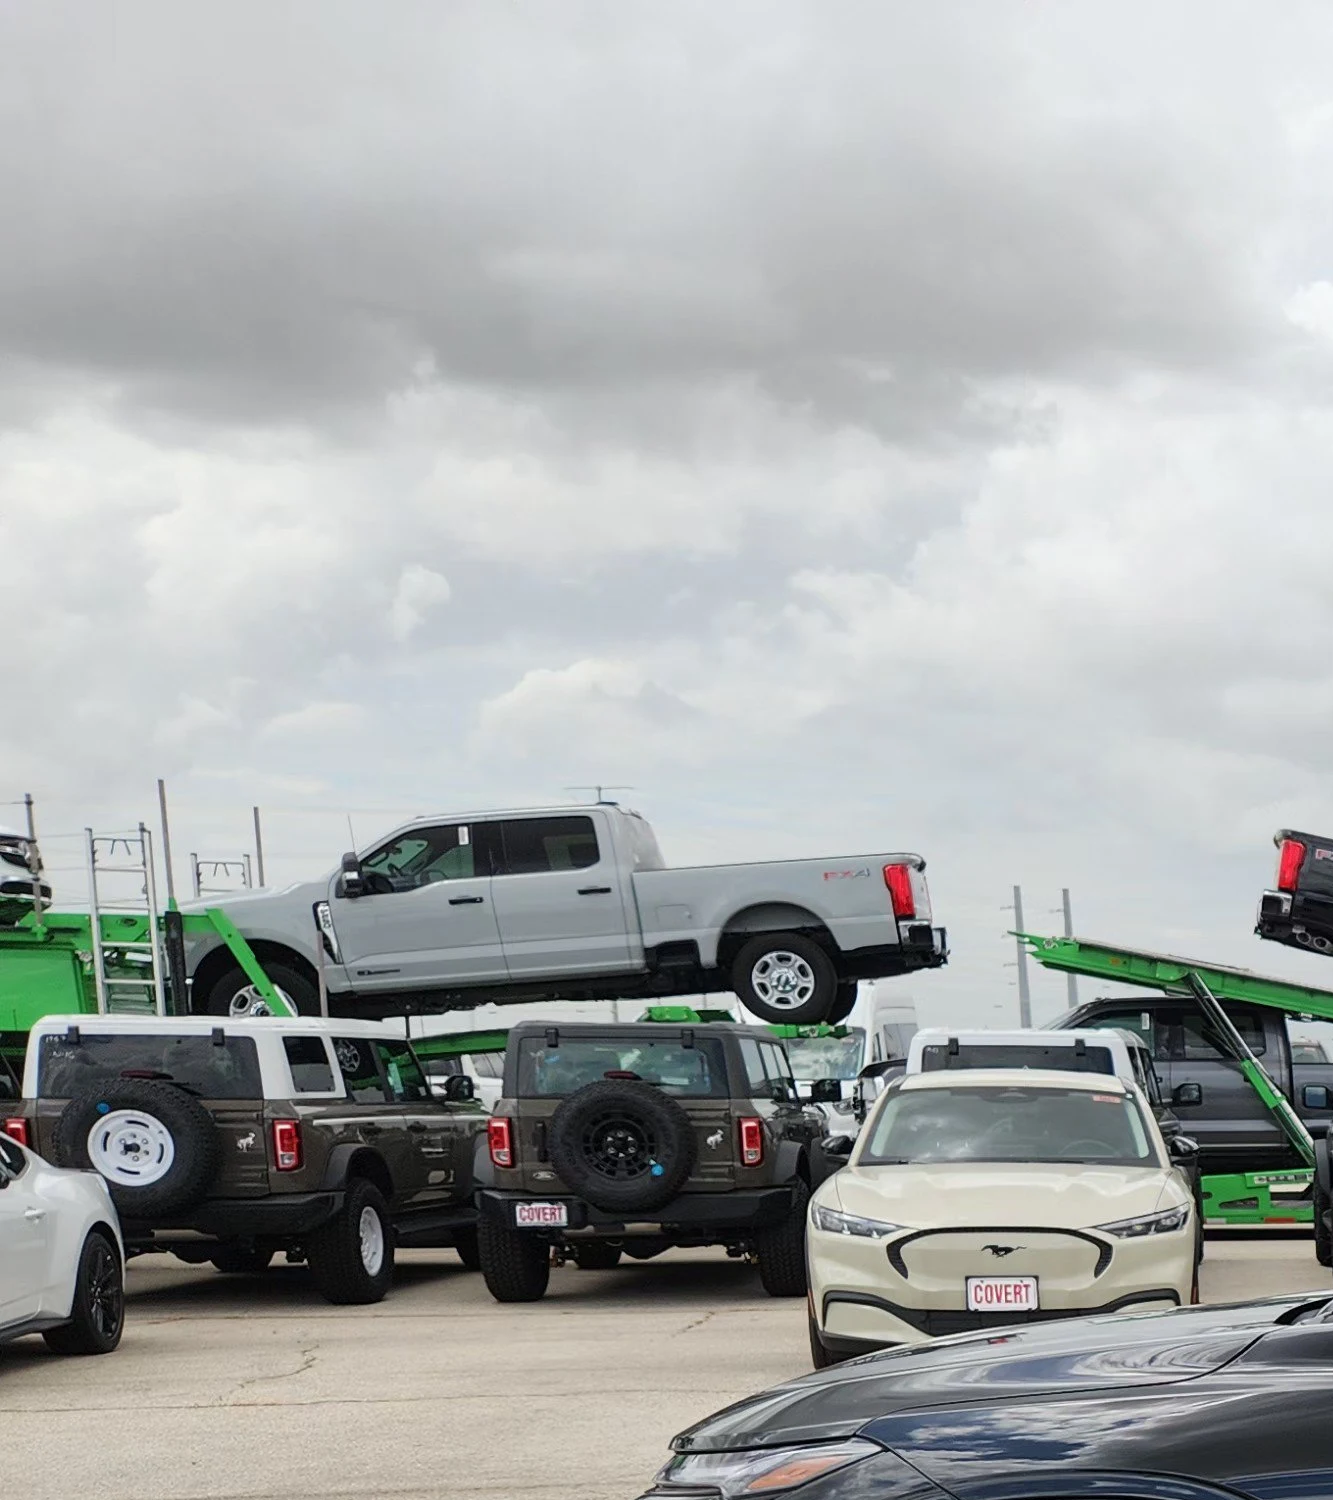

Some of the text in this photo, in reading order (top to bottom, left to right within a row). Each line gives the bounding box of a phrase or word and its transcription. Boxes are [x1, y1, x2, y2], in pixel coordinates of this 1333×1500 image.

[823, 867, 870, 880] FX4
[519, 1206, 563, 1222] COVERT
[974, 1283, 1032, 1305] COVERT
